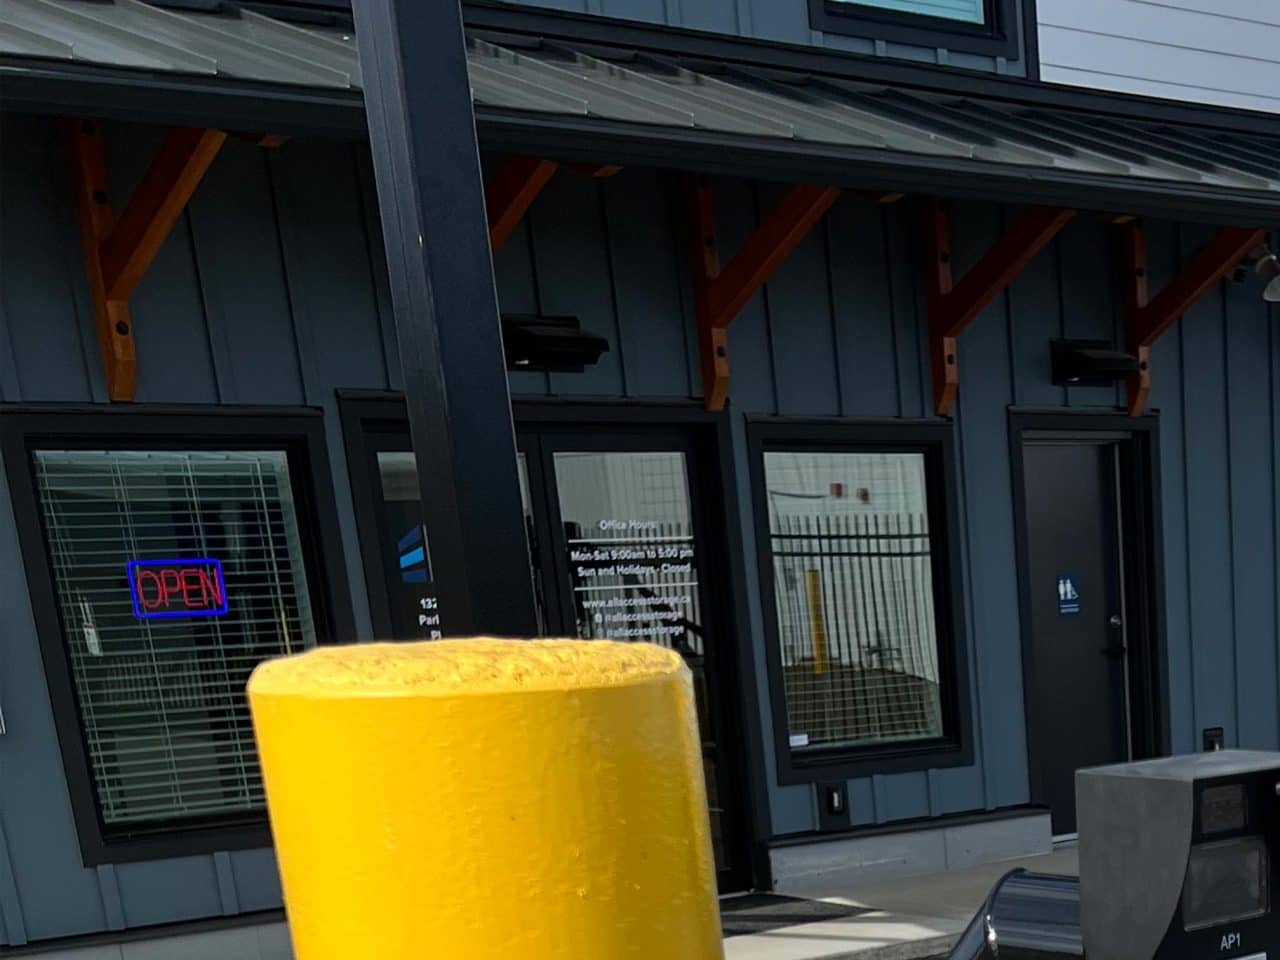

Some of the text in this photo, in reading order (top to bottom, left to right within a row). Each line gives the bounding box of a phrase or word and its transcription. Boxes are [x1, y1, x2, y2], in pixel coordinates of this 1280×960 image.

[647, 549, 657, 558] to
[658, 547, 679, 558] 5:00
[680, 549, 694, 559] pm
[577, 566, 597, 577] Sun
[598, 565, 615, 576] and
[616, 563, 655, 576] Holidays
[661, 562, 691, 573] Closed
[137, 567, 223, 609] OPEN
[1219, 932, 1241, 950] AP1
